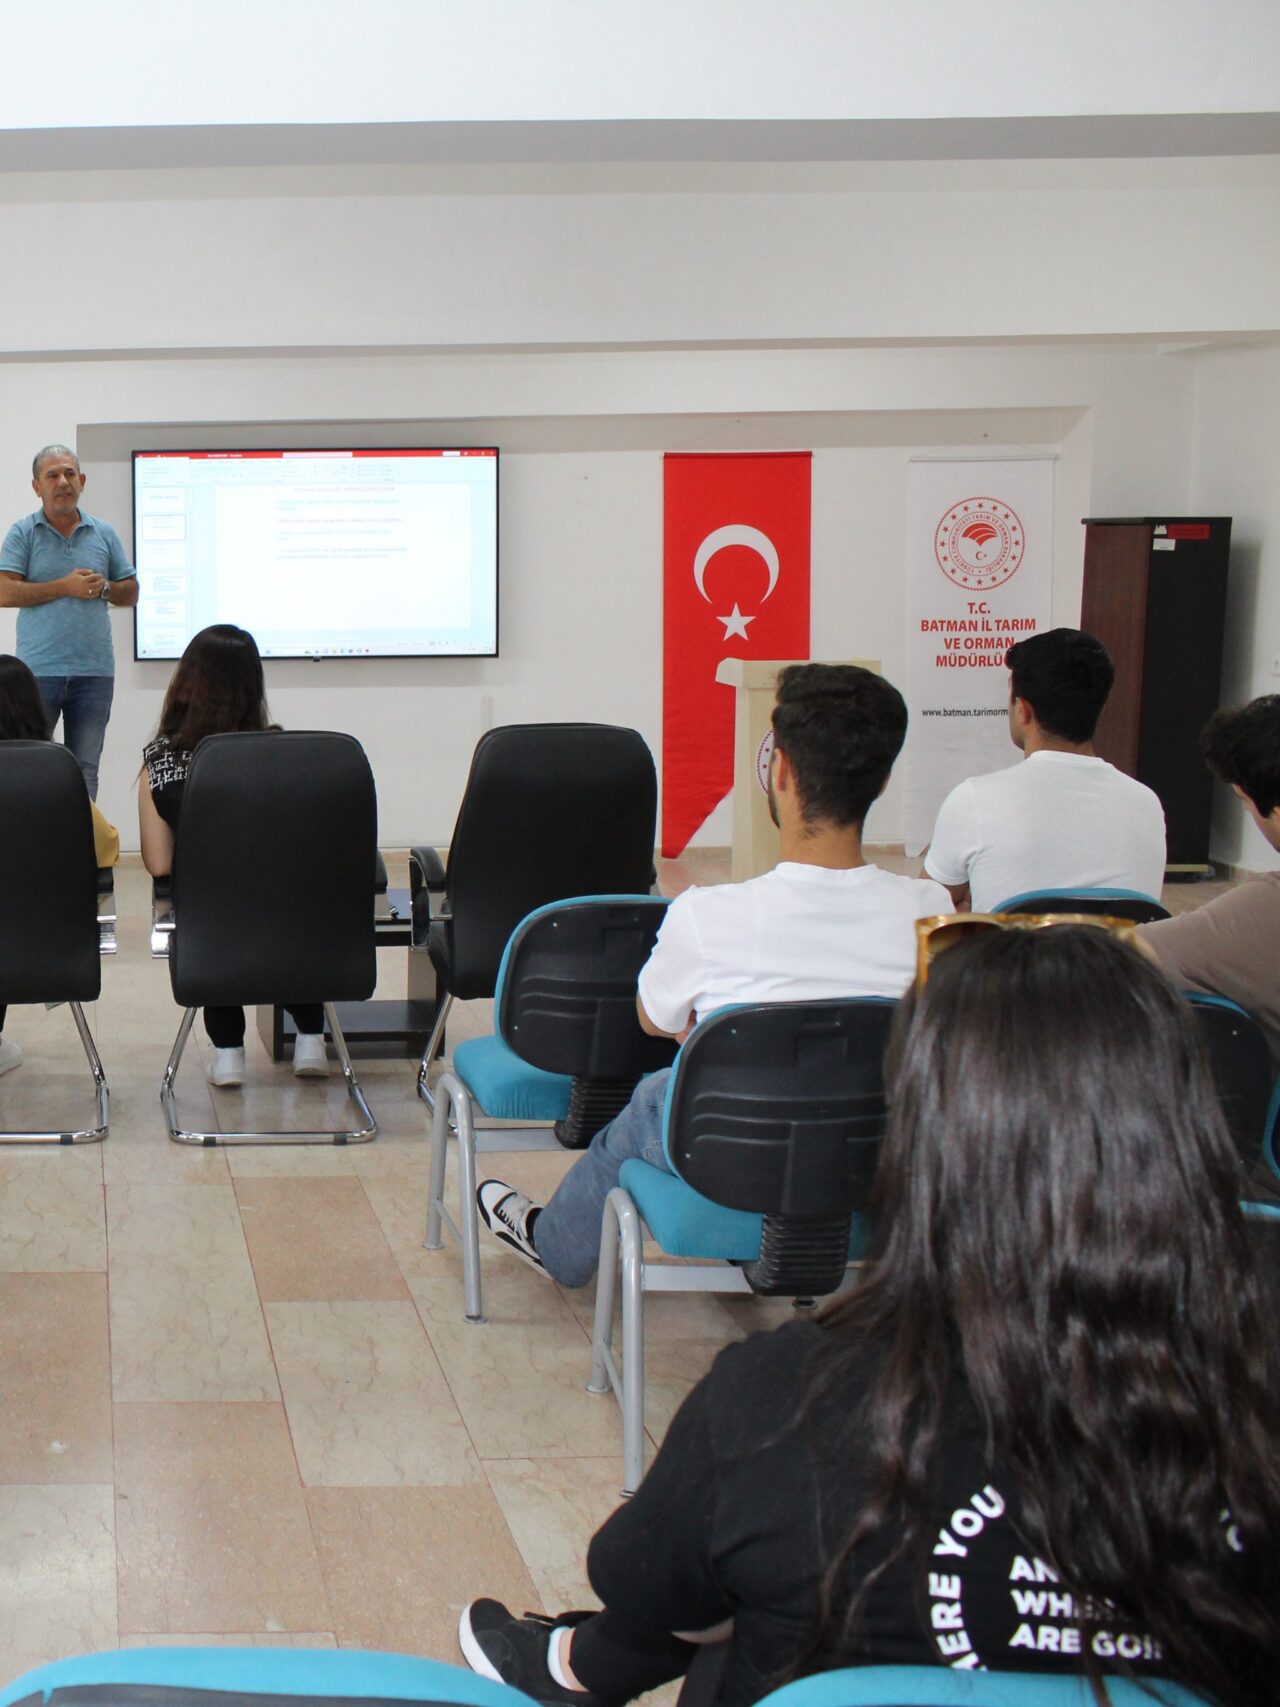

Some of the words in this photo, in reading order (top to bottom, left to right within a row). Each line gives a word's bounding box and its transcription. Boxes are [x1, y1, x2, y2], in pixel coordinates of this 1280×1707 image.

[968, 602, 991, 614] T.C.
[921, 620, 978, 632] BATMAN
[981, 617, 992, 632] İL
[995, 619, 1036, 631] TARIM
[944, 638, 960, 649] VE
[964, 637, 1014, 649] ORMAN
[936, 652, 1008, 667] MÜDÜRLÜ
[932, 1484, 1006, 1558] YOU
[1008, 1622, 1081, 1654] ARE
